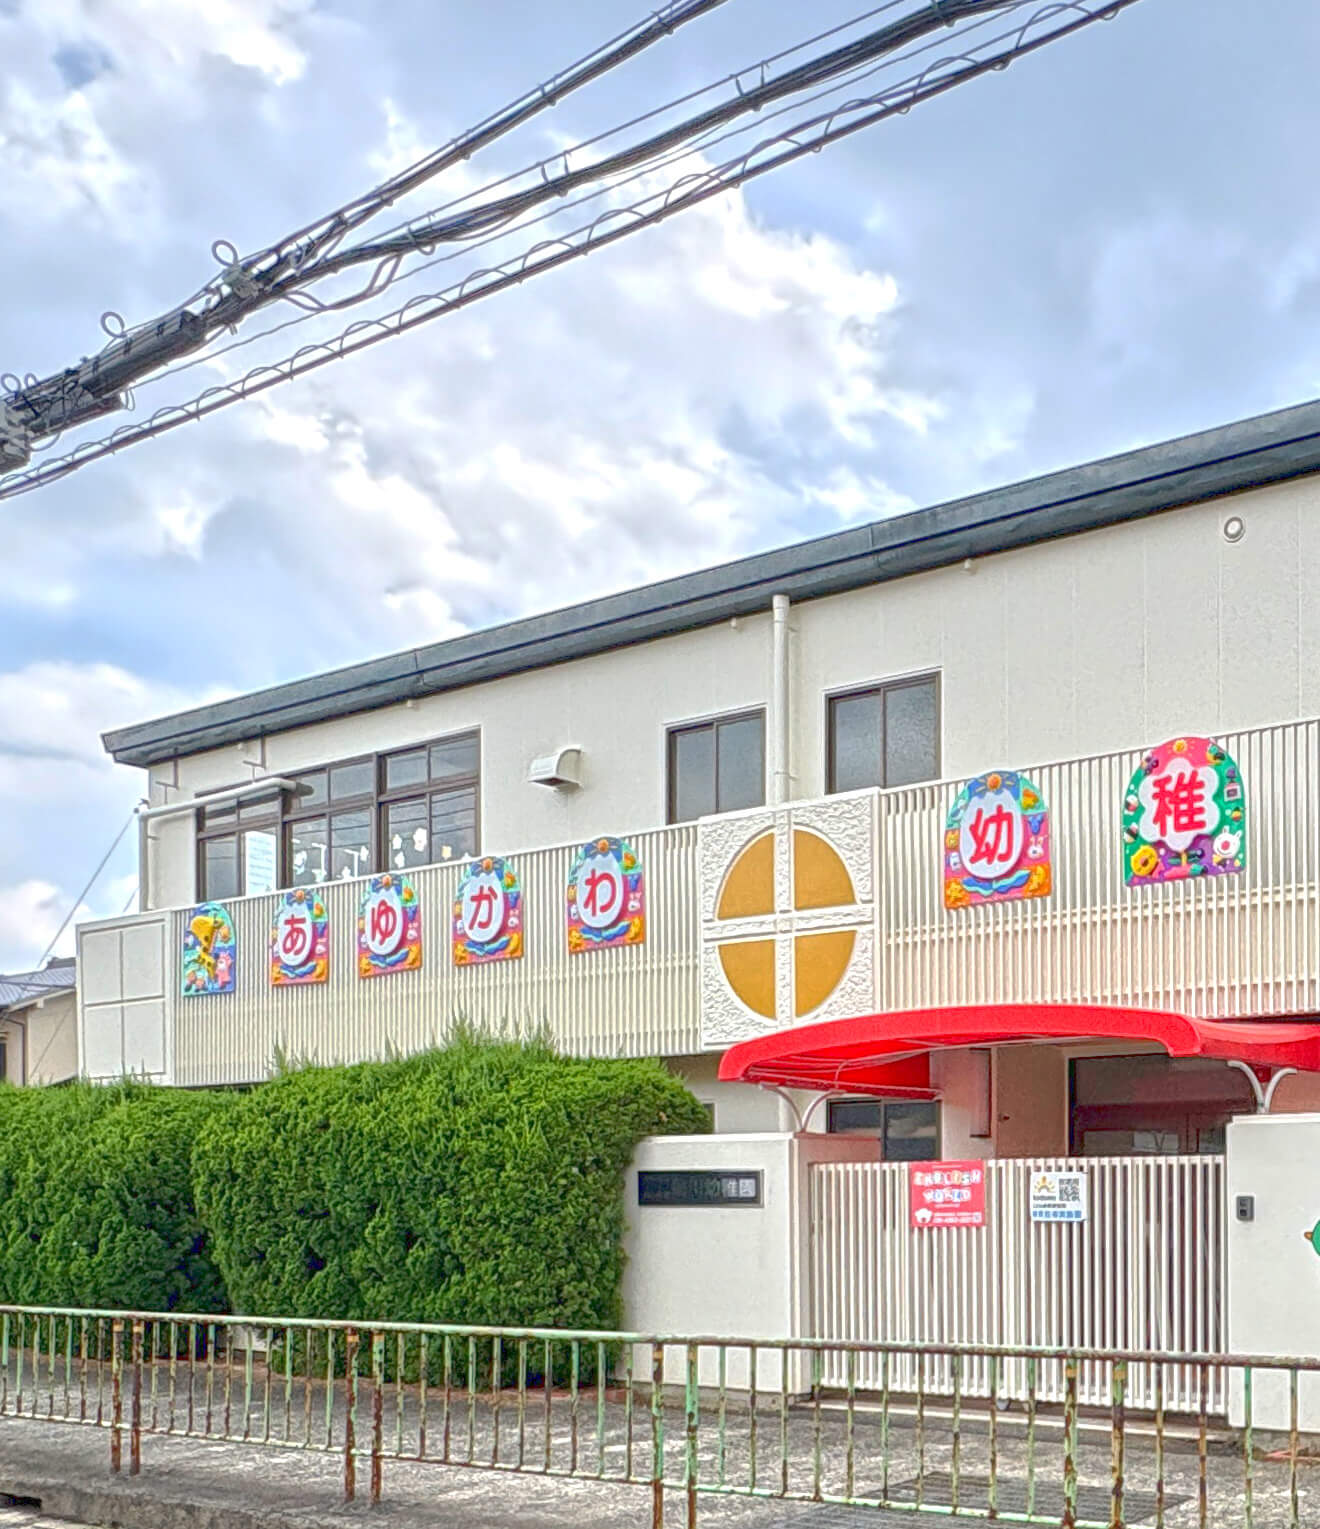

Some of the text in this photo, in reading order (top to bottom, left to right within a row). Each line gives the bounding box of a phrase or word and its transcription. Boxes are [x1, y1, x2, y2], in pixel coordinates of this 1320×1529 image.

[969, 805, 1014, 865] 幼
[1151, 769, 1206, 836] 稚
[283, 870, 616, 956] あ ゆ か わ
[914, 1169, 981, 1186] ENGLISH
